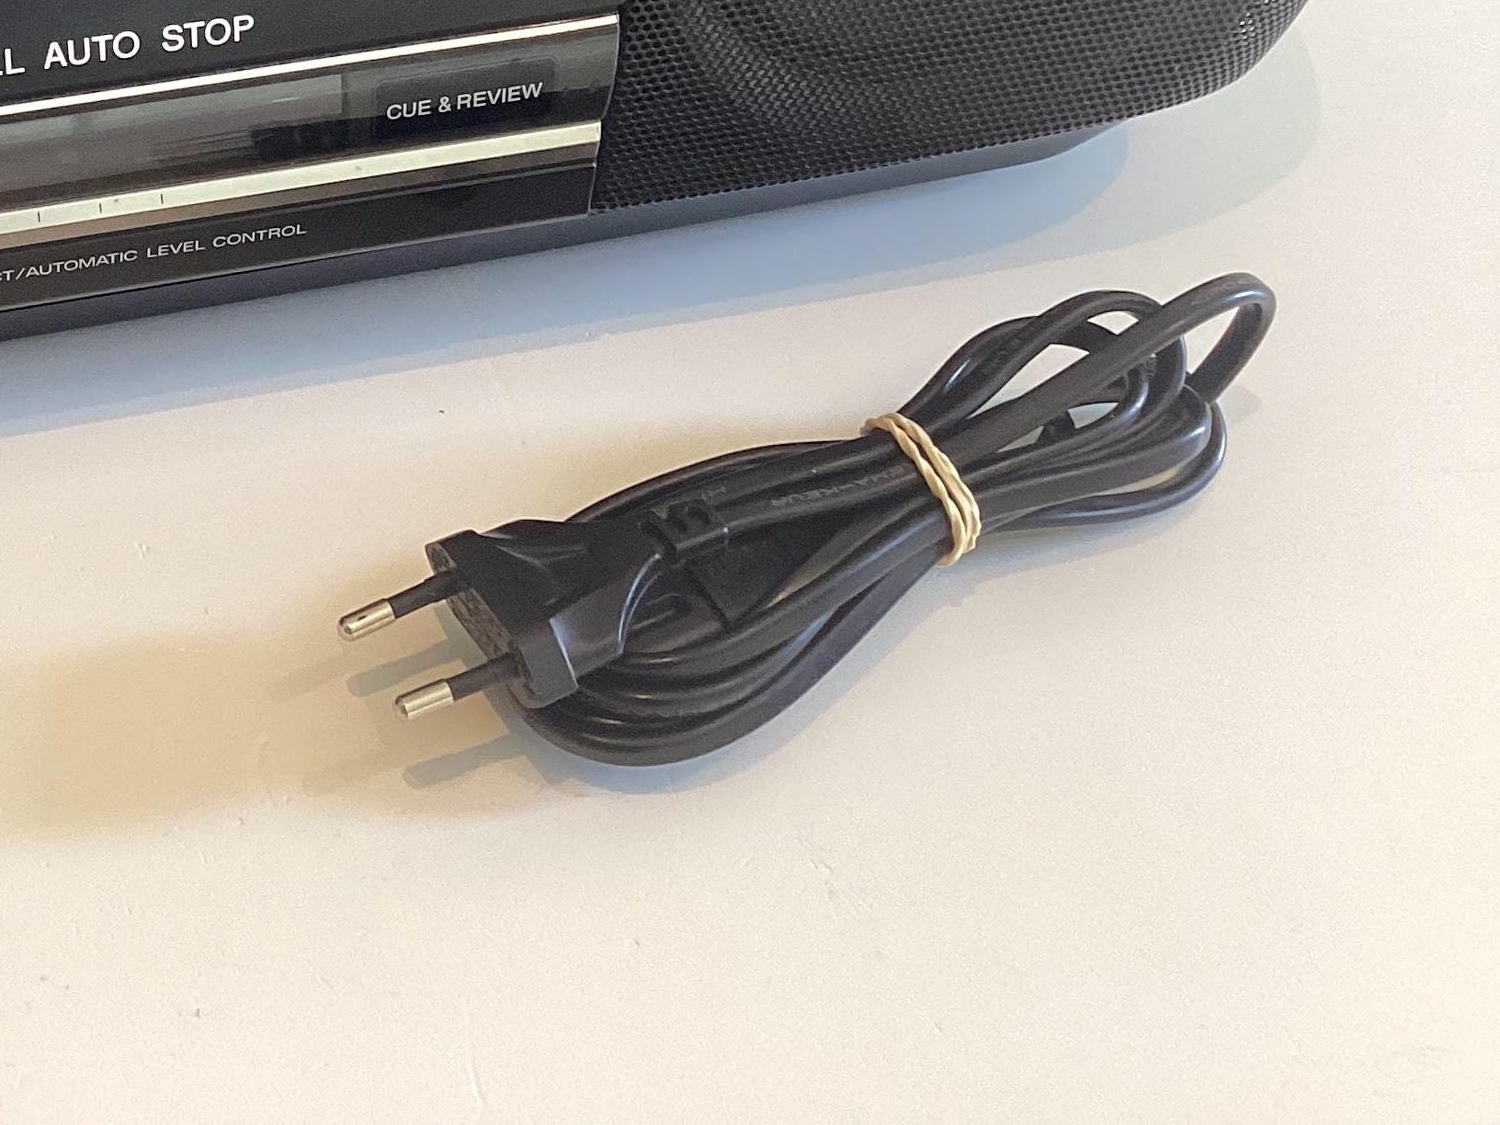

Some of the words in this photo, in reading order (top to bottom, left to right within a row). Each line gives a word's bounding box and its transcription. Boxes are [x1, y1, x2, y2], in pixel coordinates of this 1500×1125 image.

[43, 30, 141, 70] AUTO
[161, 14, 255, 53] STOP
[386, 99, 432, 121] CUE
[437, 96, 452, 114] &
[456, 81, 543, 110] REVIEW
[146, 239, 206, 259] LEVEL
[212, 224, 307, 249] CONTROL
